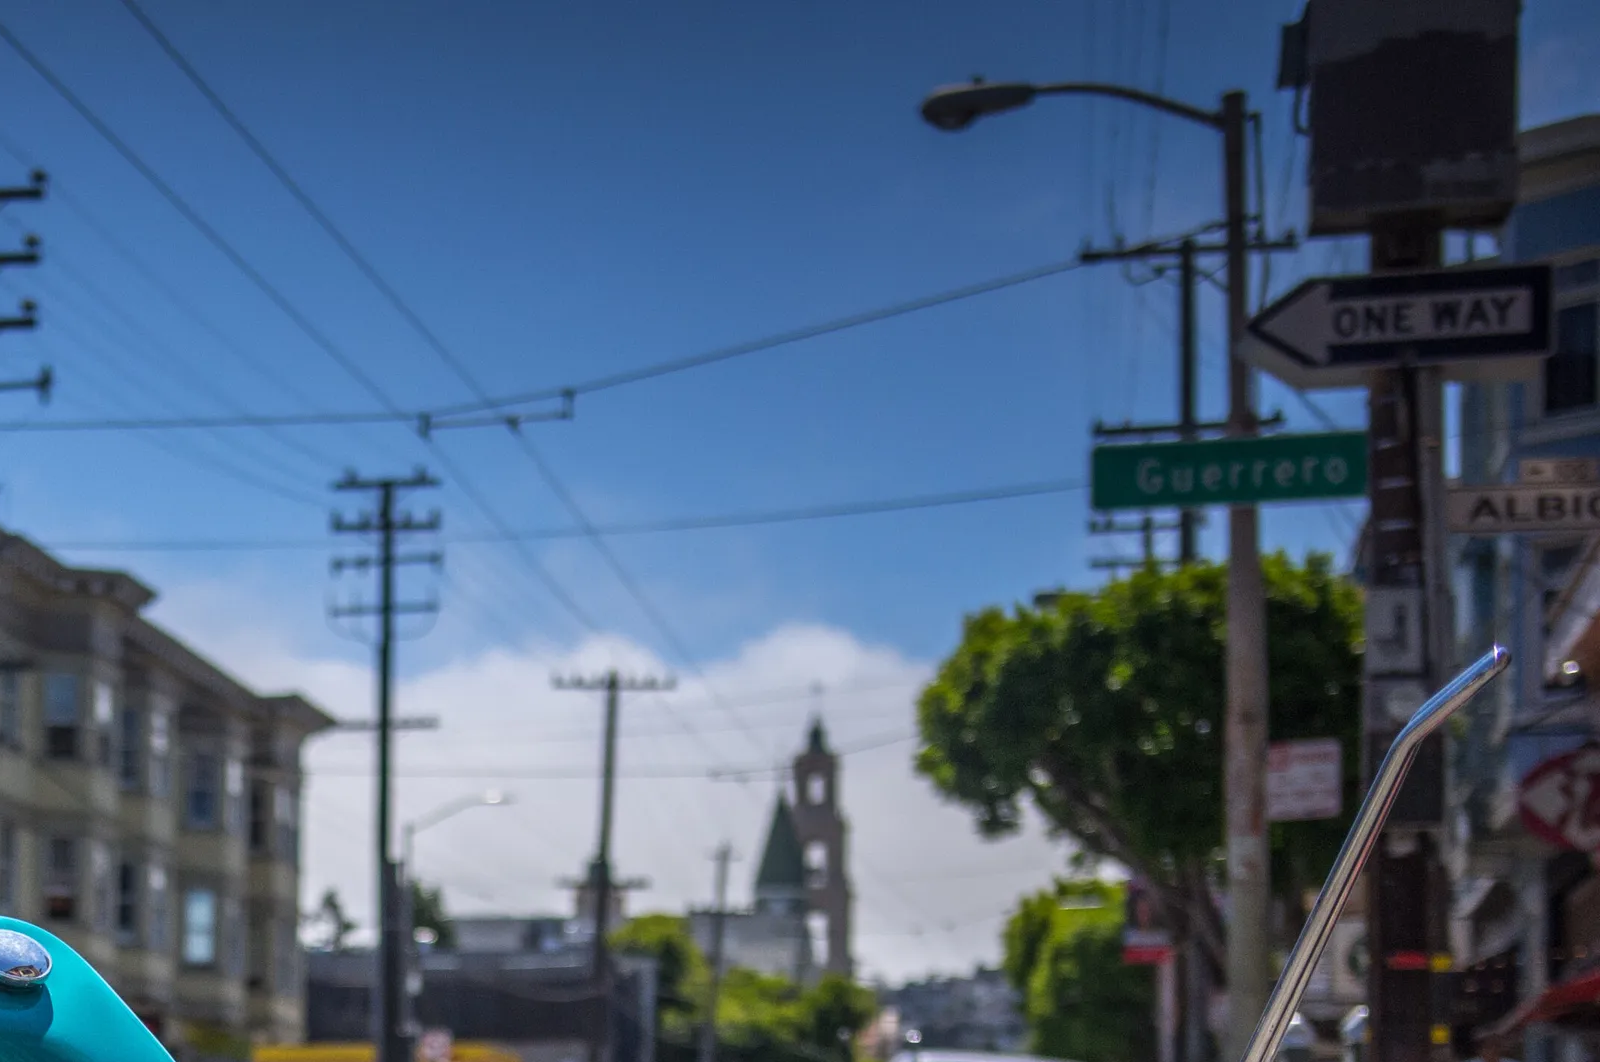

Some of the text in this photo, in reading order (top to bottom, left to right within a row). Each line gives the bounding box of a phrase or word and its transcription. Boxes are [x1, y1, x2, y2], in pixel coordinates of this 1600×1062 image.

[1332, 296, 1516, 338] ONE WAY
[1136, 456, 1349, 494] Guerrero
